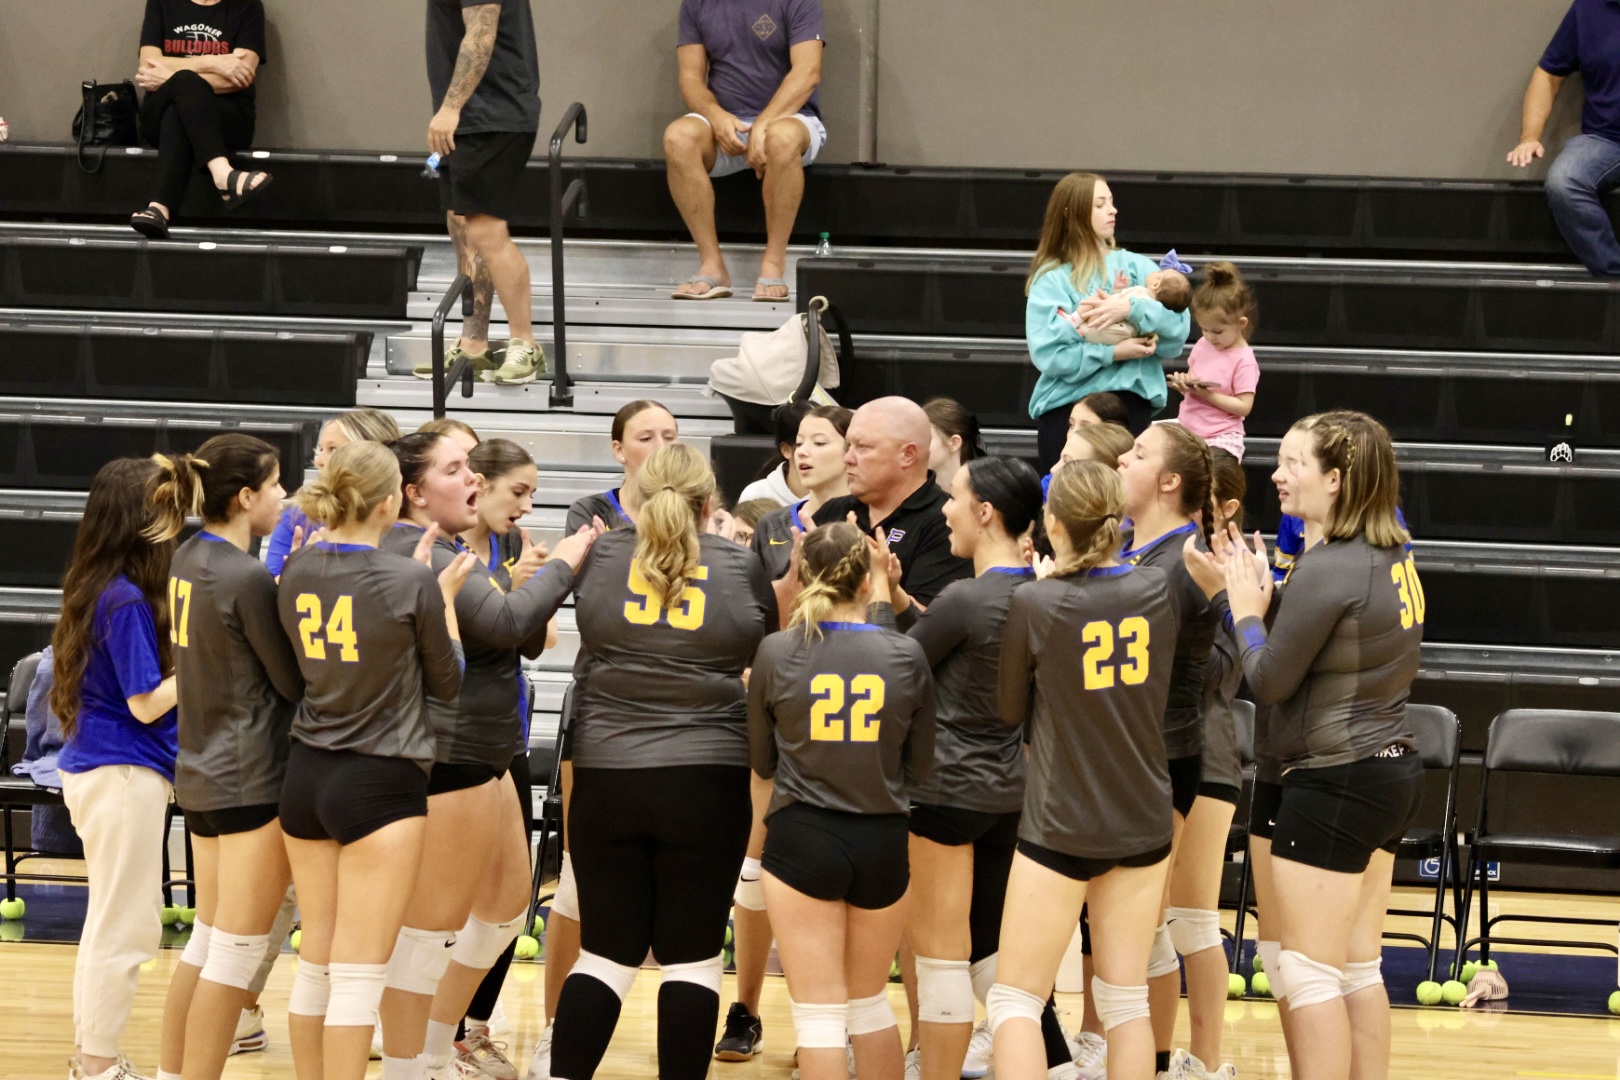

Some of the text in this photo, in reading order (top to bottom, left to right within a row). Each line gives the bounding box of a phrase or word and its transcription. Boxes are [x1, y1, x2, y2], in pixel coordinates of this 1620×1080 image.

[164, 39, 230, 55] BULLDOGS
[173, 23, 223, 38] WAGONER
[169, 576, 192, 648] 17
[295, 592, 360, 662] 24
[1390, 558, 1426, 630] 30
[1081, 615, 1151, 691] 23
[810, 673, 886, 742] 22
